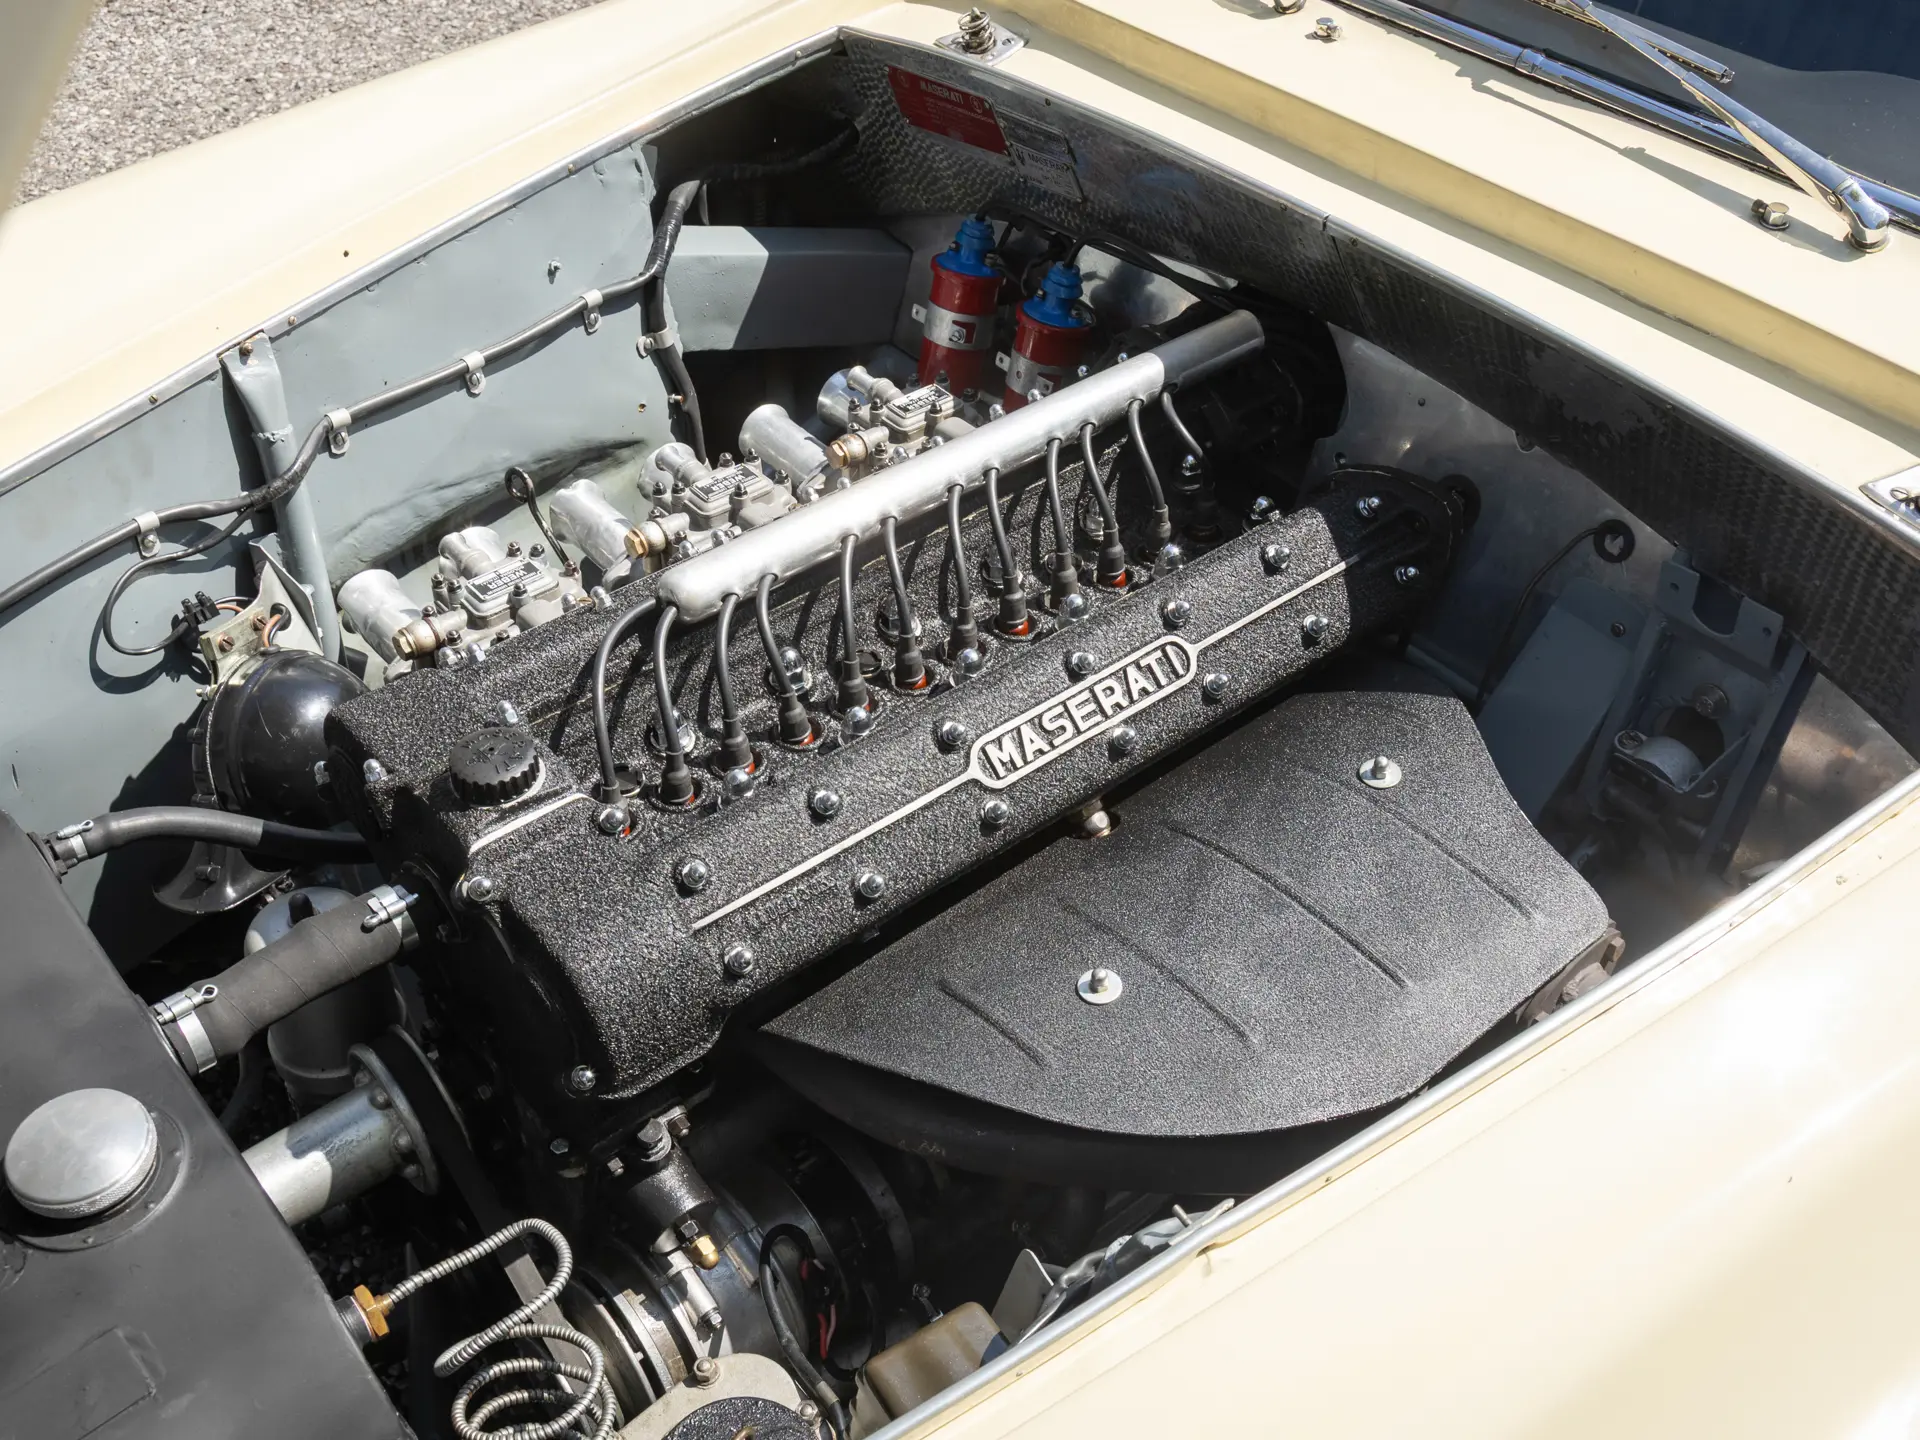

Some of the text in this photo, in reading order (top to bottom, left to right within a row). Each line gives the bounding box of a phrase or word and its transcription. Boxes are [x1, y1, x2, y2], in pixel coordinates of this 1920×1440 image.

[919, 80, 964, 105] MASERATI
[709, 473, 744, 491] WEBER
[486, 568, 527, 590] WEBER
[984, 645, 1185, 778] MASERATI
